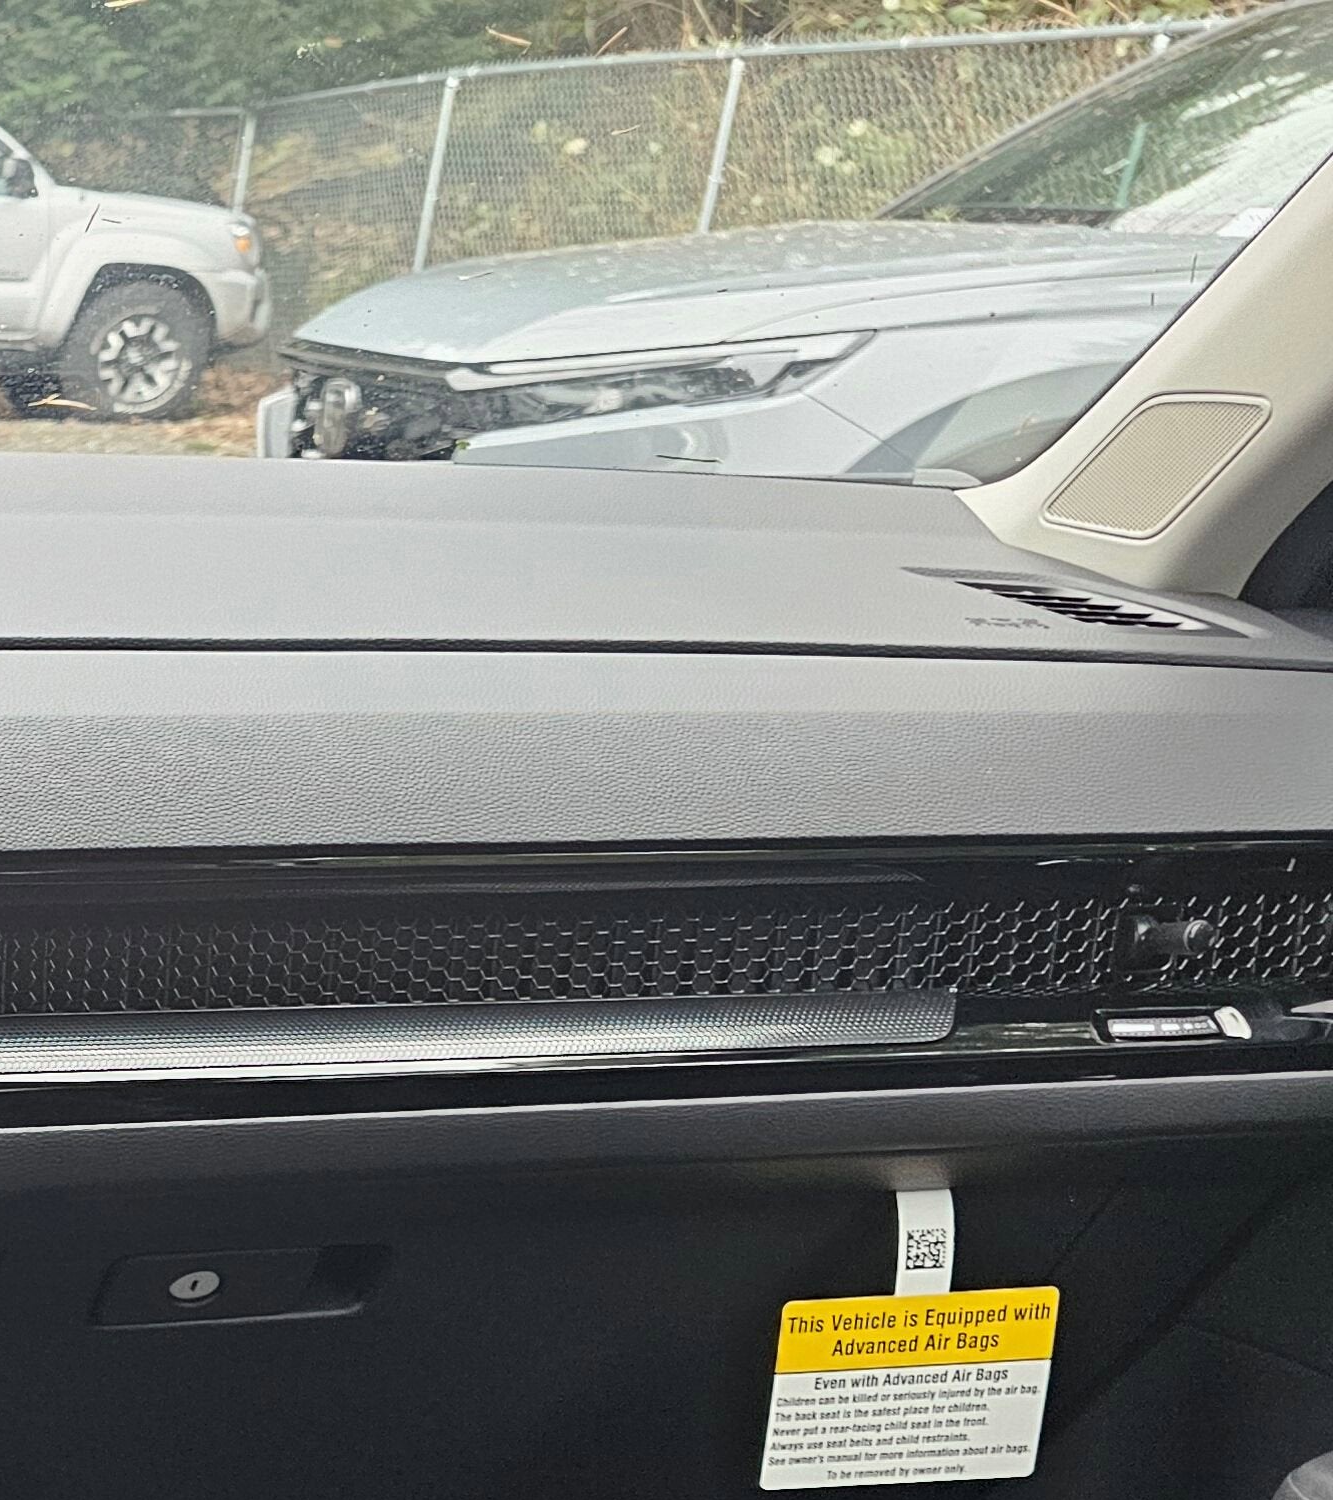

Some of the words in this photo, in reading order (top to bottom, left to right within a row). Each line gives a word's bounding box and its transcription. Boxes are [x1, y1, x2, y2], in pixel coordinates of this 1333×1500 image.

[789, 1316, 824, 1334] This
[832, 1312, 896, 1332] Vehicle
[904, 1310, 918, 1328] is
[925, 1305, 1007, 1328] Equipped
[1014, 1302, 1051, 1321] with
[832, 1336, 919, 1356] Advanced
[925, 1334, 951, 1351] Air
[957, 1332, 999, 1352] Bags
[815, 1377, 846, 1390] Even
[851, 1374, 878, 1388] with
[882, 1371, 948, 1387] Advanced
[953, 1370, 972, 1382] Air
[976, 1368, 1009, 1382] Bags
[777, 1397, 816, 1407] Children
[819, 1397, 835, 1405] can
[838, 1395, 849, 1404] be
[853, 1393, 878, 1403] killed
[893, 1390, 936, 1402] seriously
[938, 1388, 971, 1400] injured
[974, 1388, 985, 1398] by
[988, 1387, 1002, 1396] the
[1005, 1386, 1018, 1395] air
[776, 1412, 791, 1422] The
[795, 1412, 816, 1421] back
[820, 1410, 840, 1419] seat
[843, 1410, 851, 1418] is
[854, 1408, 869, 1418] the
[872, 1407, 901, 1416] safest
[903, 1406, 929, 1417] place
[933, 1405, 945, 1413] for
[948, 1403, 989, 1412] children.
[773, 1428, 800, 1436] Never
[803, 1426, 818, 1436] put
[829, 1424, 881, 1433] rear-facing
[884, 1420, 908, 1431] child
[910, 1420, 931, 1429] seat
[945, 1418, 960, 1427] the
[963, 1417, 989, 1426] front.
[770, 1442, 803, 1452] Always
[807, 1441, 823, 1449] use
[827, 1439, 846, 1448] seat
[849, 1438, 872, 1447] belts
[876, 1436, 893, 1446] and
[896, 1435, 919, 1444] child
[922, 1433, 970, 1442] restraints.
[769, 1457, 786, 1466] See
[789, 1455, 824, 1464] owner's
[827, 1453, 862, 1463] manual
[865, 1452, 877, 1461] for
[879, 1452, 903, 1460] more
[906, 1448, 960, 1458] information
[962, 1446, 988, 1456] about
[991, 1445, 1004, 1454] air
[1006, 1445, 1030, 1455] bags.
[827, 1470, 837, 1480] To
[840, 1470, 851, 1479] be
[854, 1467, 896, 1478] removed
[899, 1467, 910, 1477] by
[913, 1466, 942, 1475] owner
